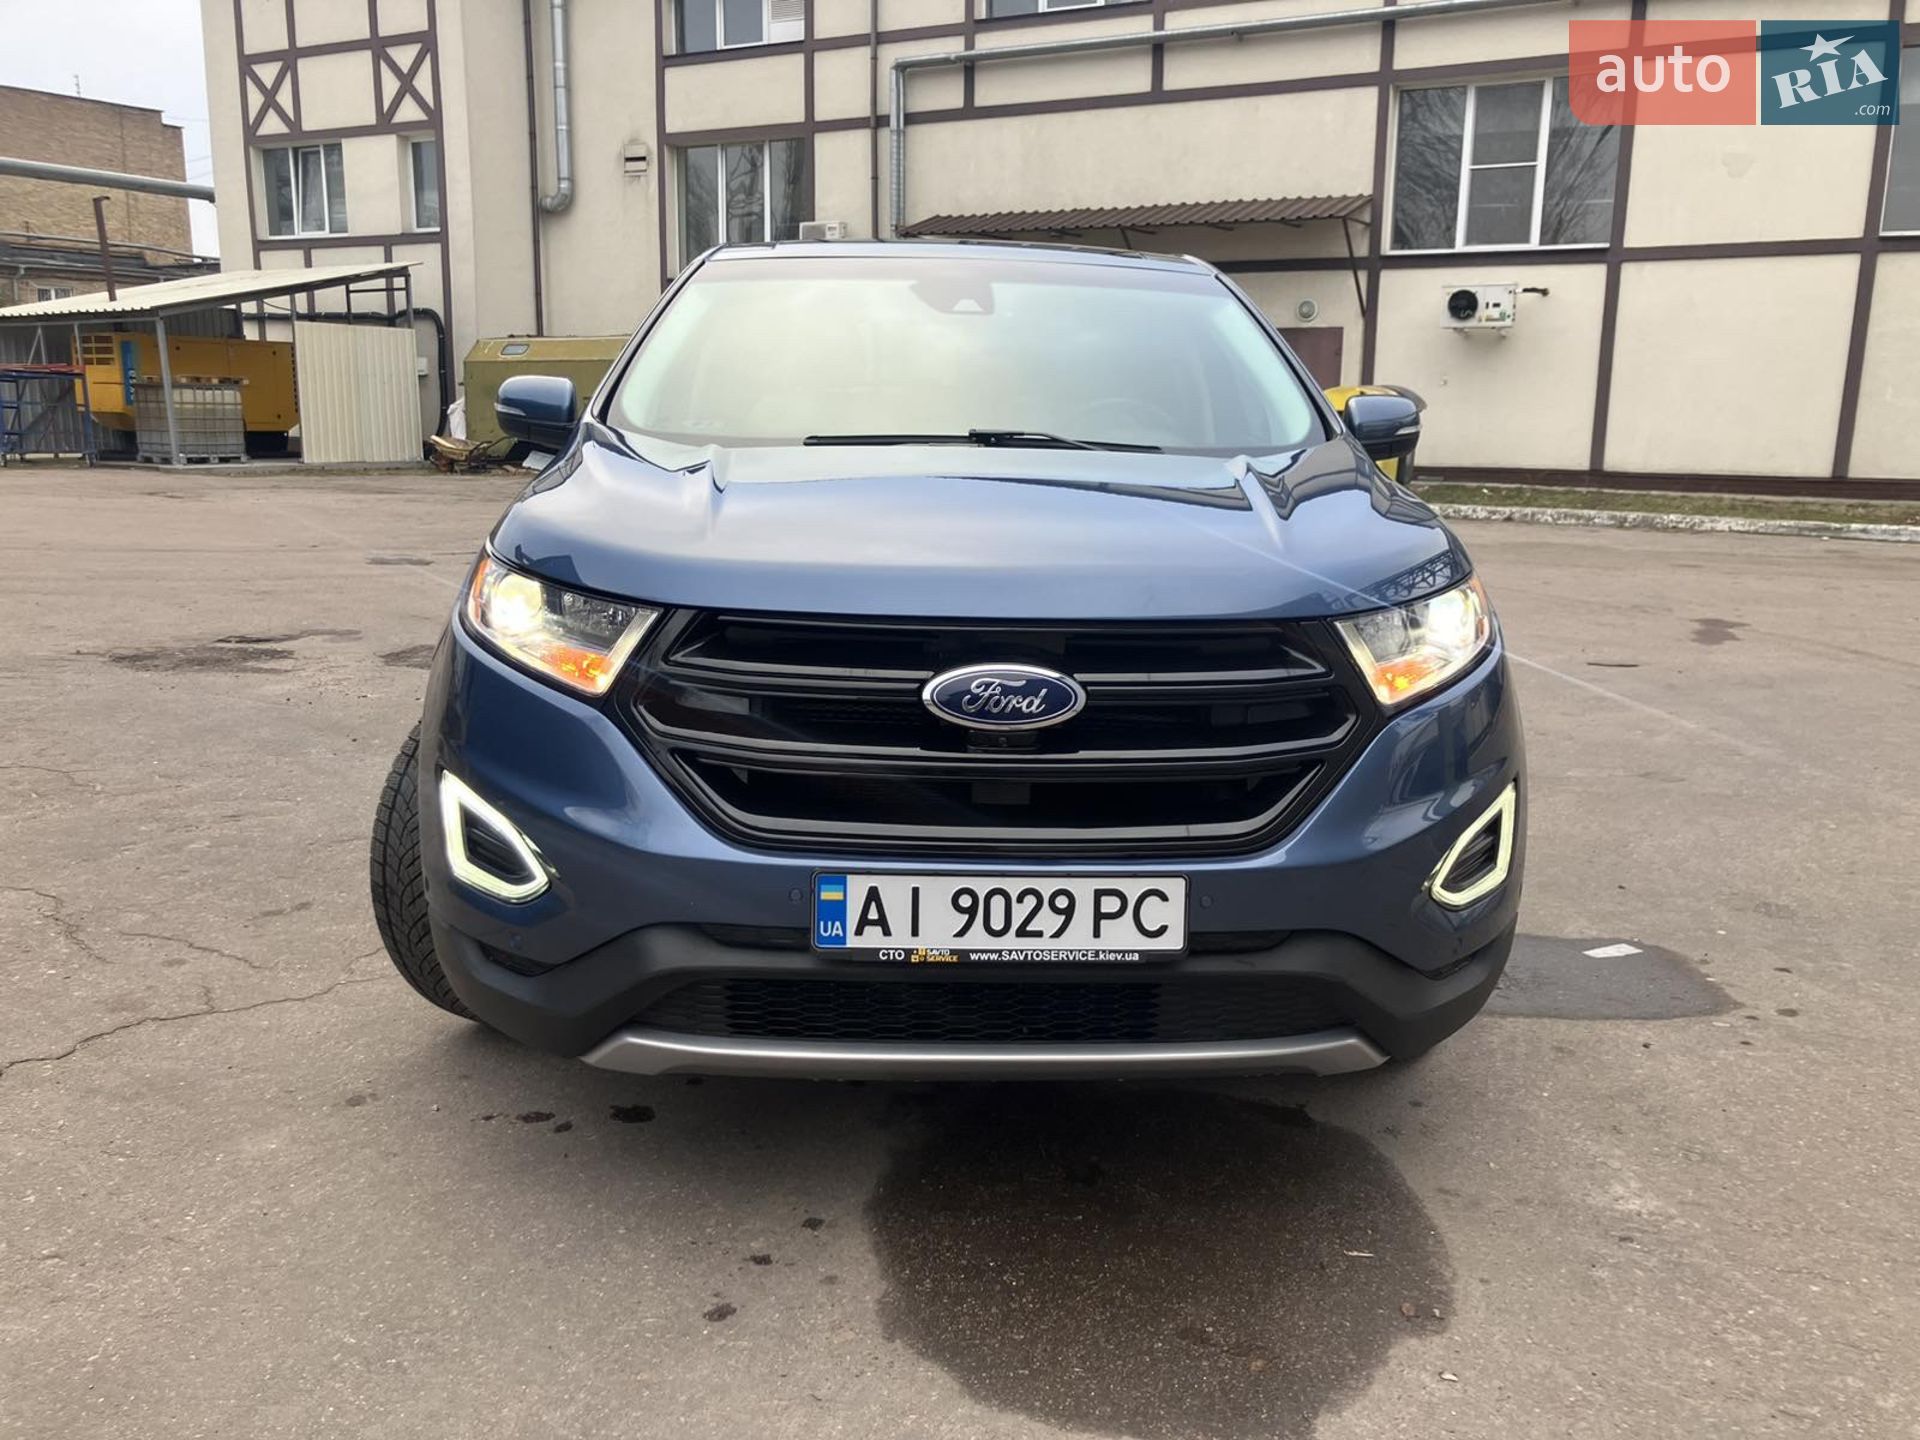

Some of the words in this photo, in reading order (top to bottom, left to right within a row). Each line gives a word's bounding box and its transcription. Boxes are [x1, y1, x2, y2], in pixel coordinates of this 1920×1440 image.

[961, 677, 1049, 713] Ford
[950, 886, 1077, 939] 9029
[1092, 887, 1170, 939] PC
[819, 920, 844, 938] UA
[969, 949, 1140, 961] www.SAVTOSERVICE.kiev.ua
